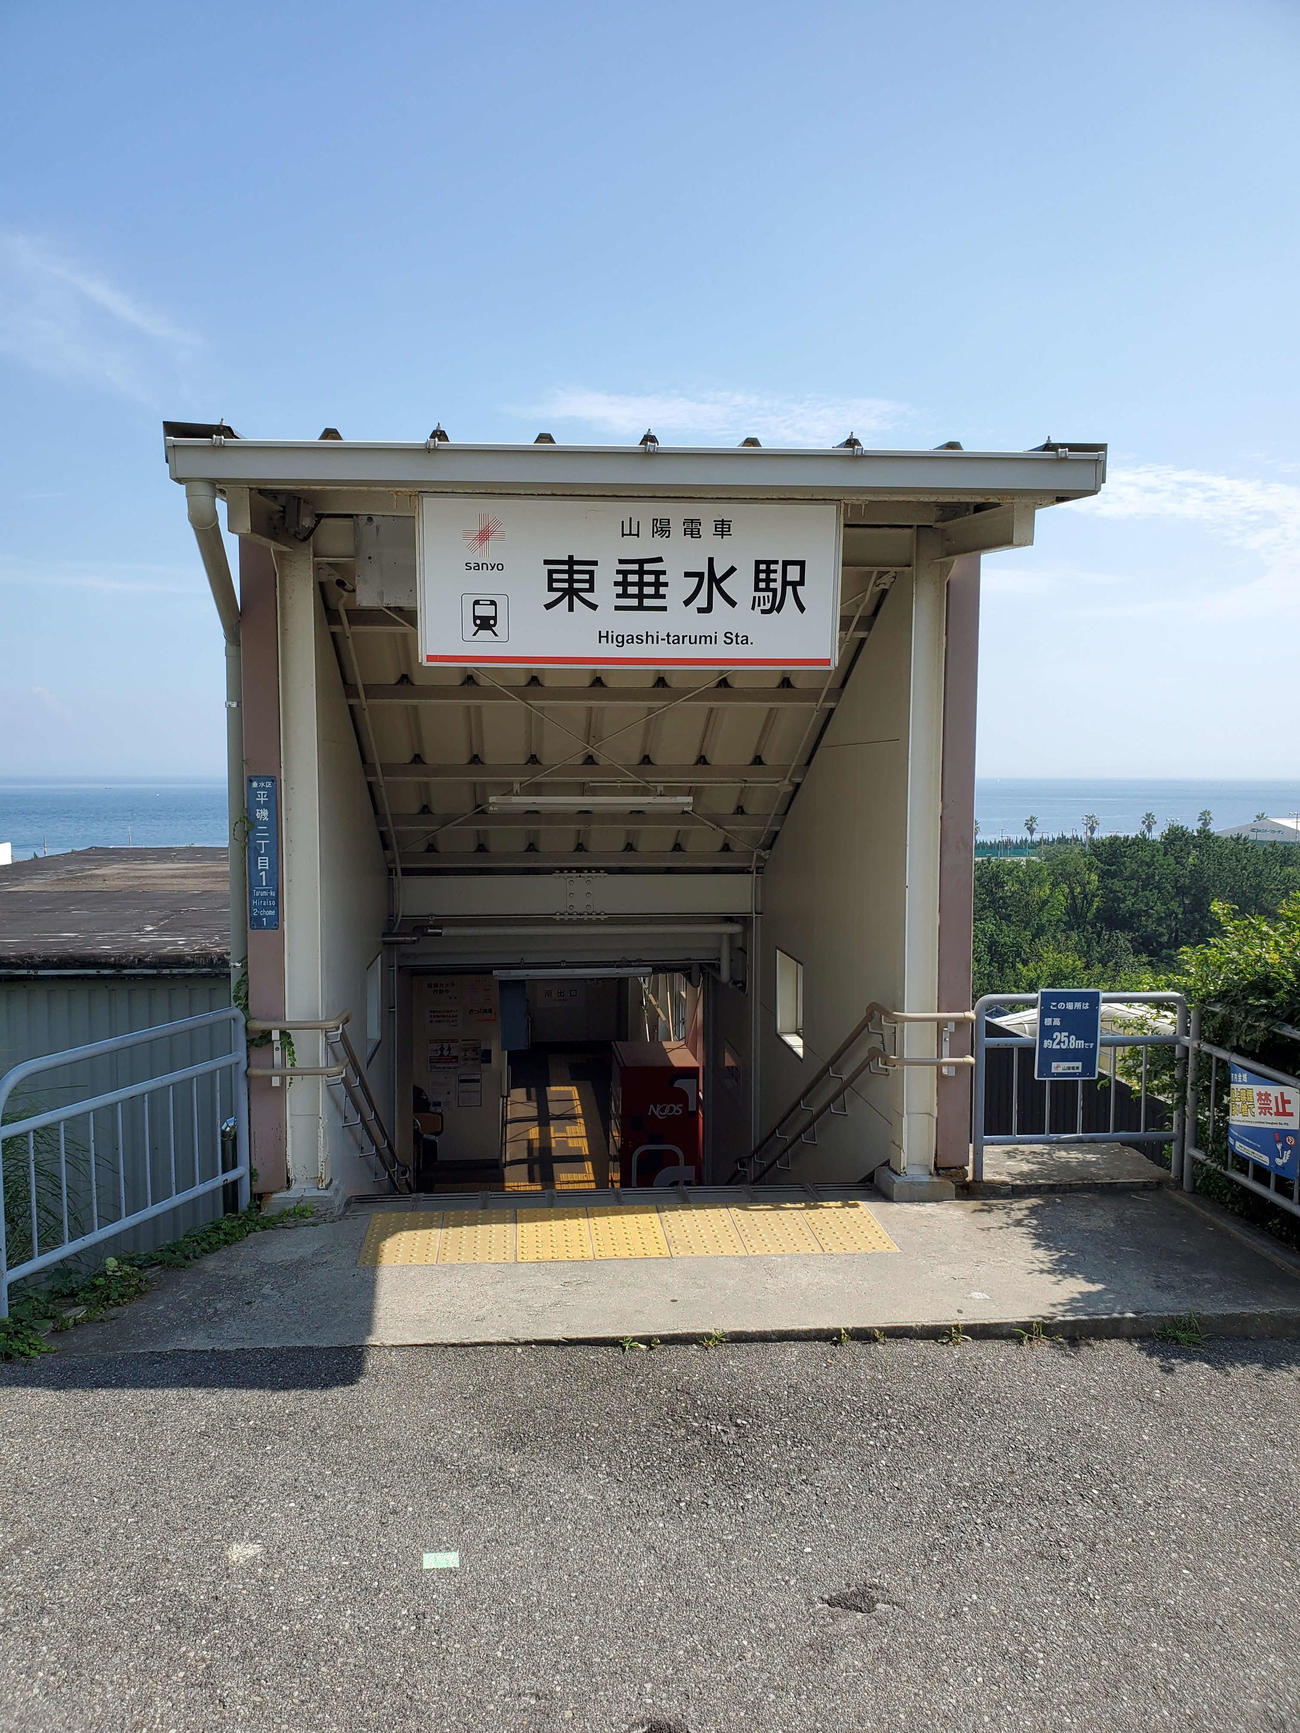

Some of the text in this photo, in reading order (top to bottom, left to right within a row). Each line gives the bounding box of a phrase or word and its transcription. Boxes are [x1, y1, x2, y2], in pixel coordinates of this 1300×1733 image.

[620, 517, 733, 539] 山陽電車
[464, 562, 505, 572] sanyo
[543, 555, 807, 615] 東垂水駅
[598, 630, 754, 647] Higashi-tarumi Sta.
[253, 908, 276, 916] 2-chome
[262, 917, 267, 926] 1
[1050, 1002, 1090, 1010] この場所は
[1256, 1091, 1294, 1117] 禁止
